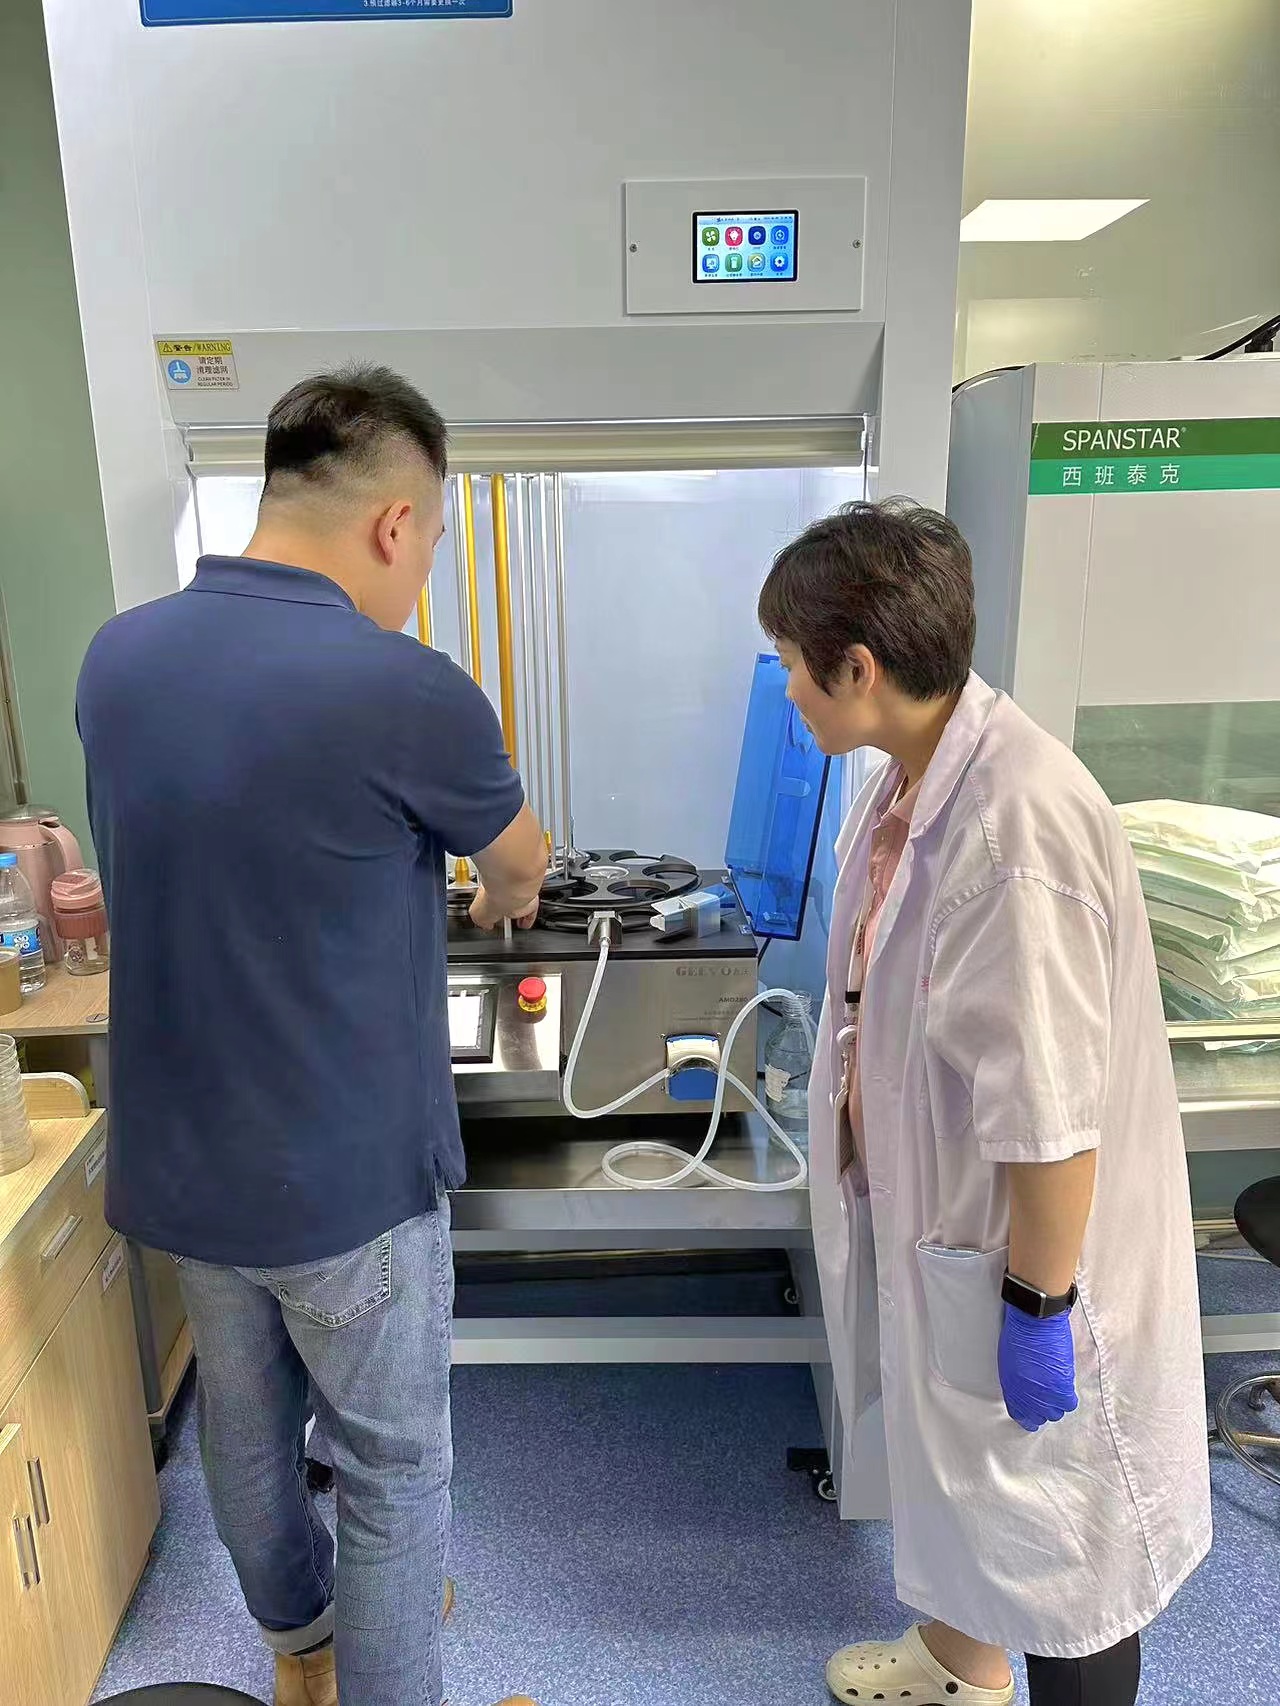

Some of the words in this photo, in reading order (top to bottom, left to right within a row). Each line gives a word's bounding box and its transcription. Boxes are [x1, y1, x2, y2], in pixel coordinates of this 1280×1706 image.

[198, 356, 223, 365] 请定期
[1062, 462, 1181, 487] 西班泰克
